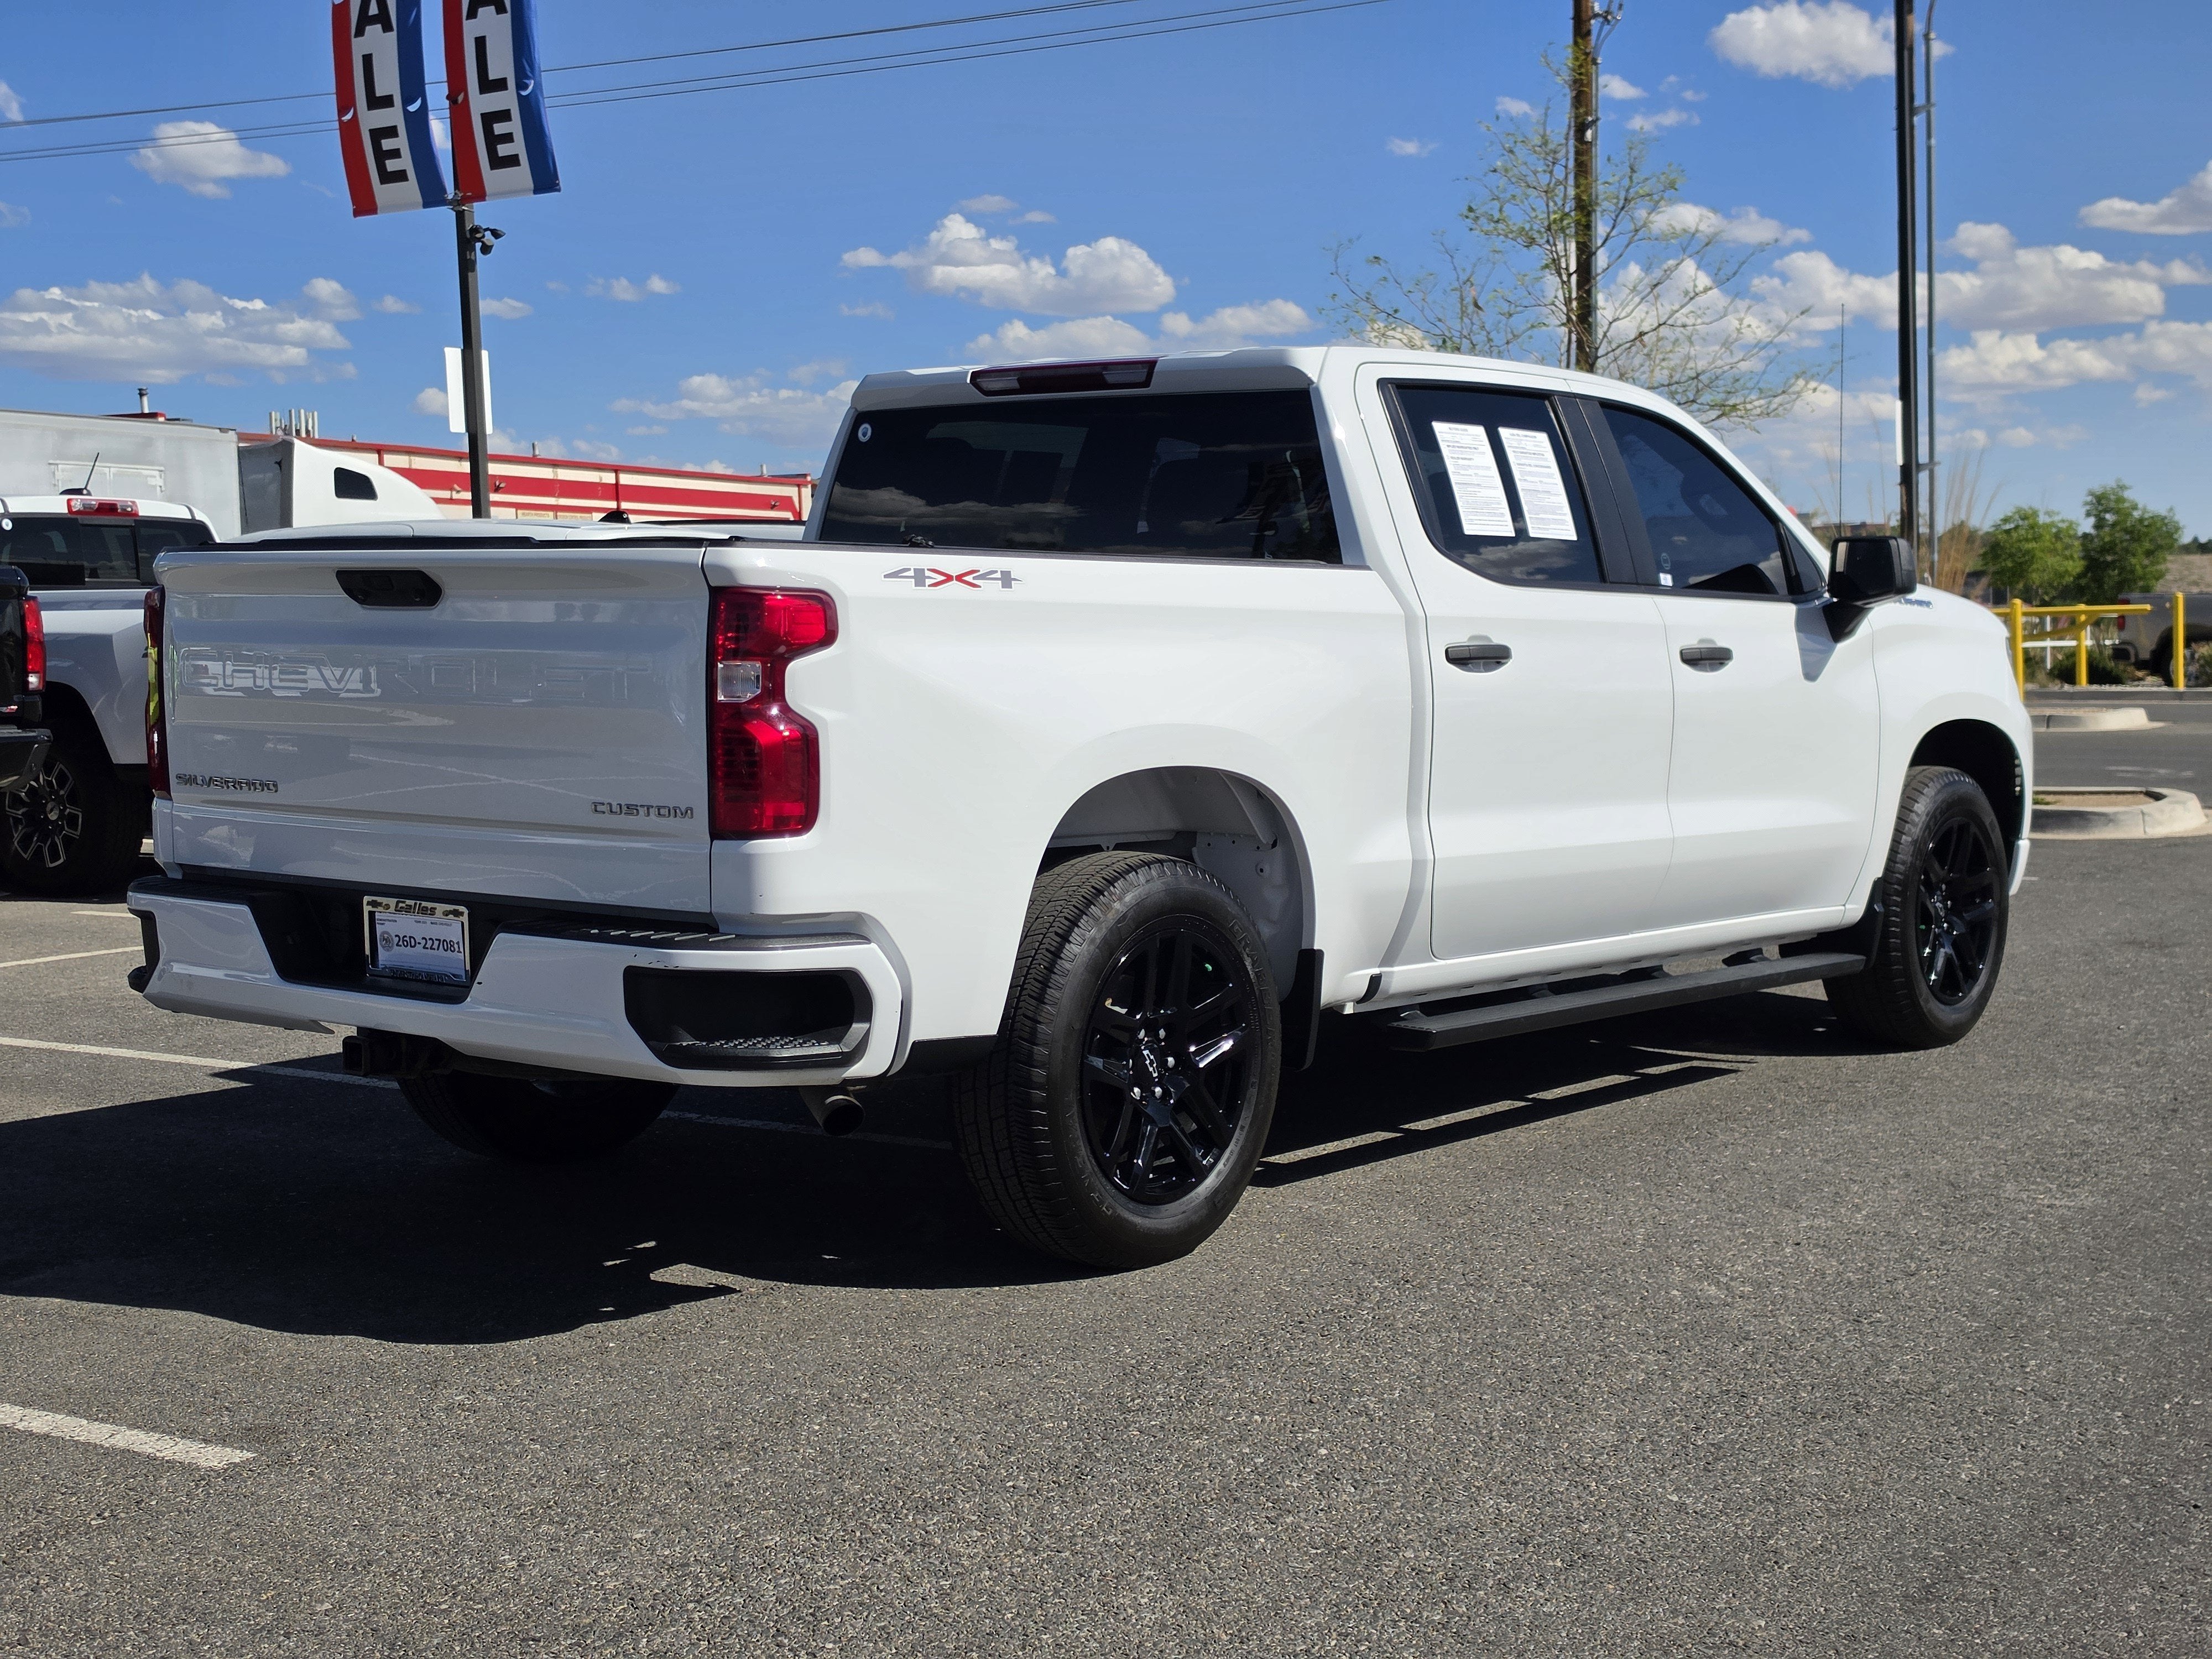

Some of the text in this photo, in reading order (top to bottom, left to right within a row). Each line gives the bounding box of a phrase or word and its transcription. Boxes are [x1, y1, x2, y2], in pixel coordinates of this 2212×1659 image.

[176, 774, 278, 792] SILVERADO
[591, 802, 694, 819] CUSTOM
[394, 900, 437, 916] Galles
[395, 934, 462, 954] 26D-227081
